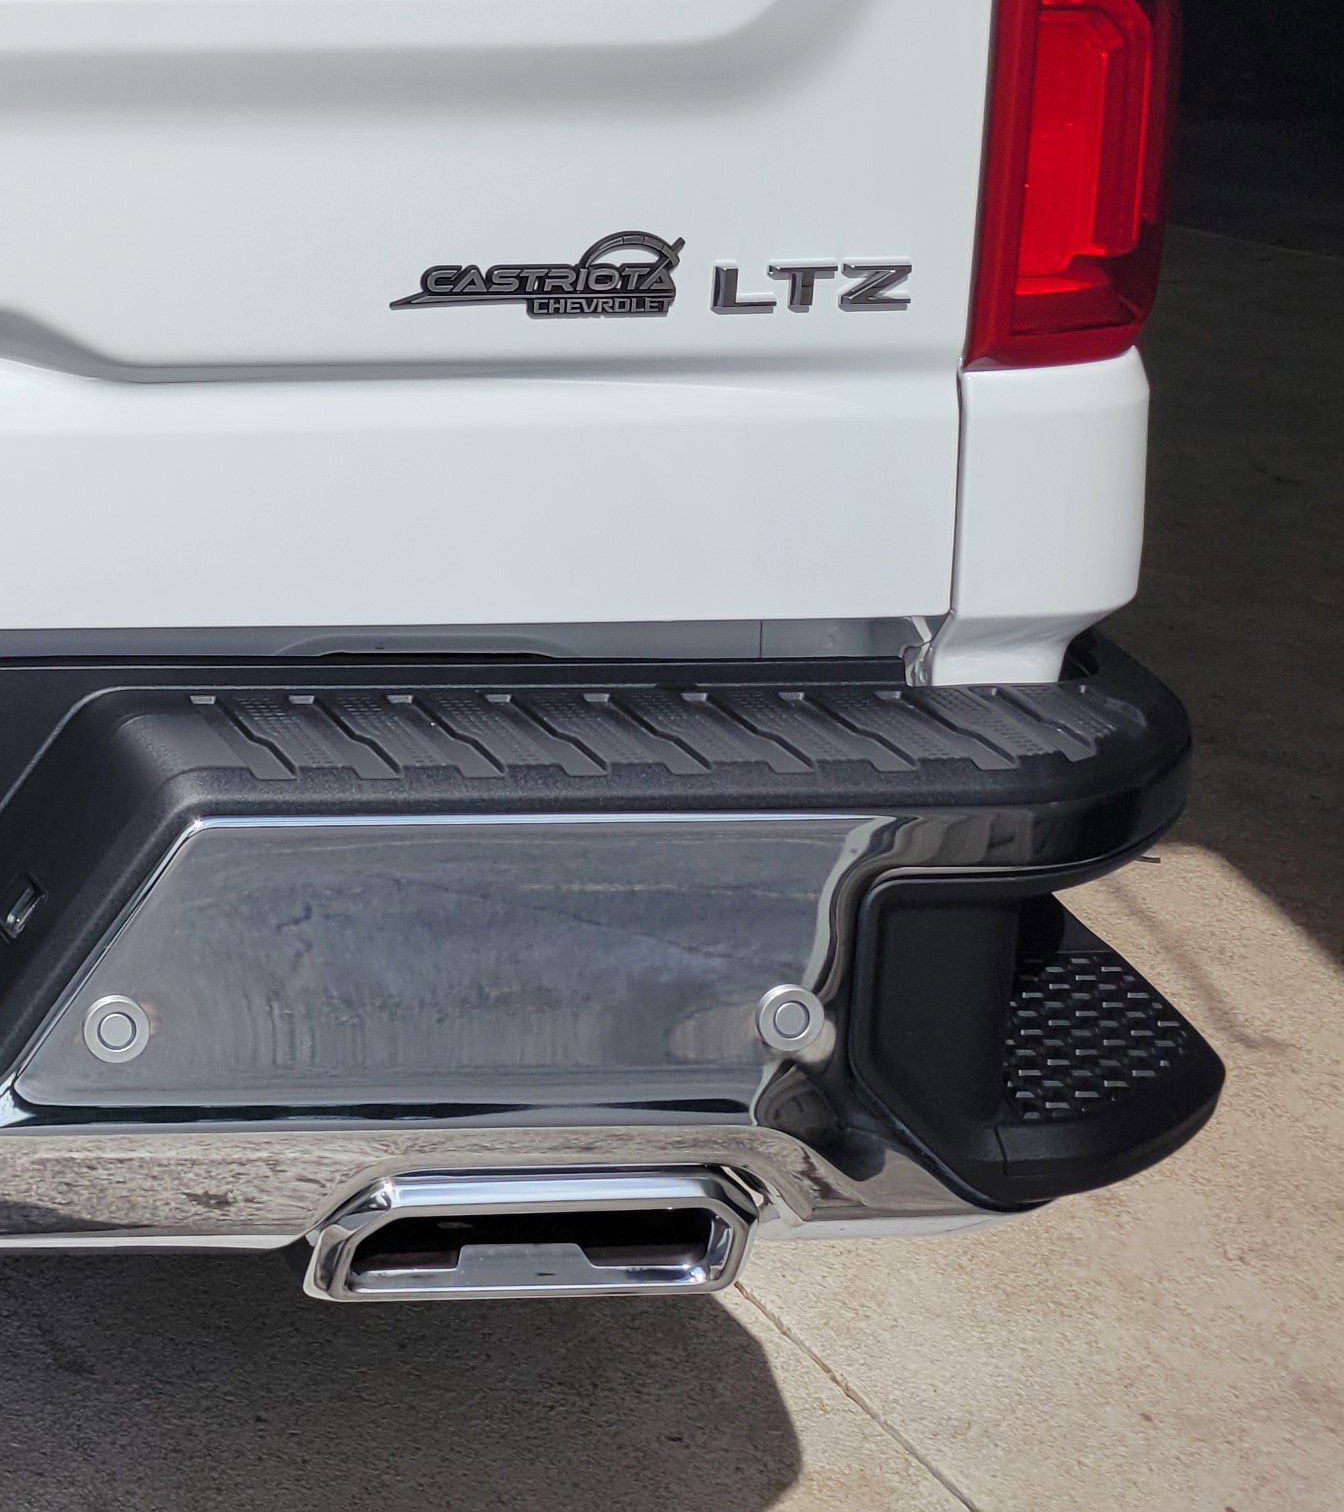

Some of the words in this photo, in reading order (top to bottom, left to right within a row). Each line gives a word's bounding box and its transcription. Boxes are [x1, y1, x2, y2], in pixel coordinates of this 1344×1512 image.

[426, 266, 674, 294] CASTRIOTA
[711, 262, 912, 314] LTZ
[532, 296, 673, 315] CHEVROLET
